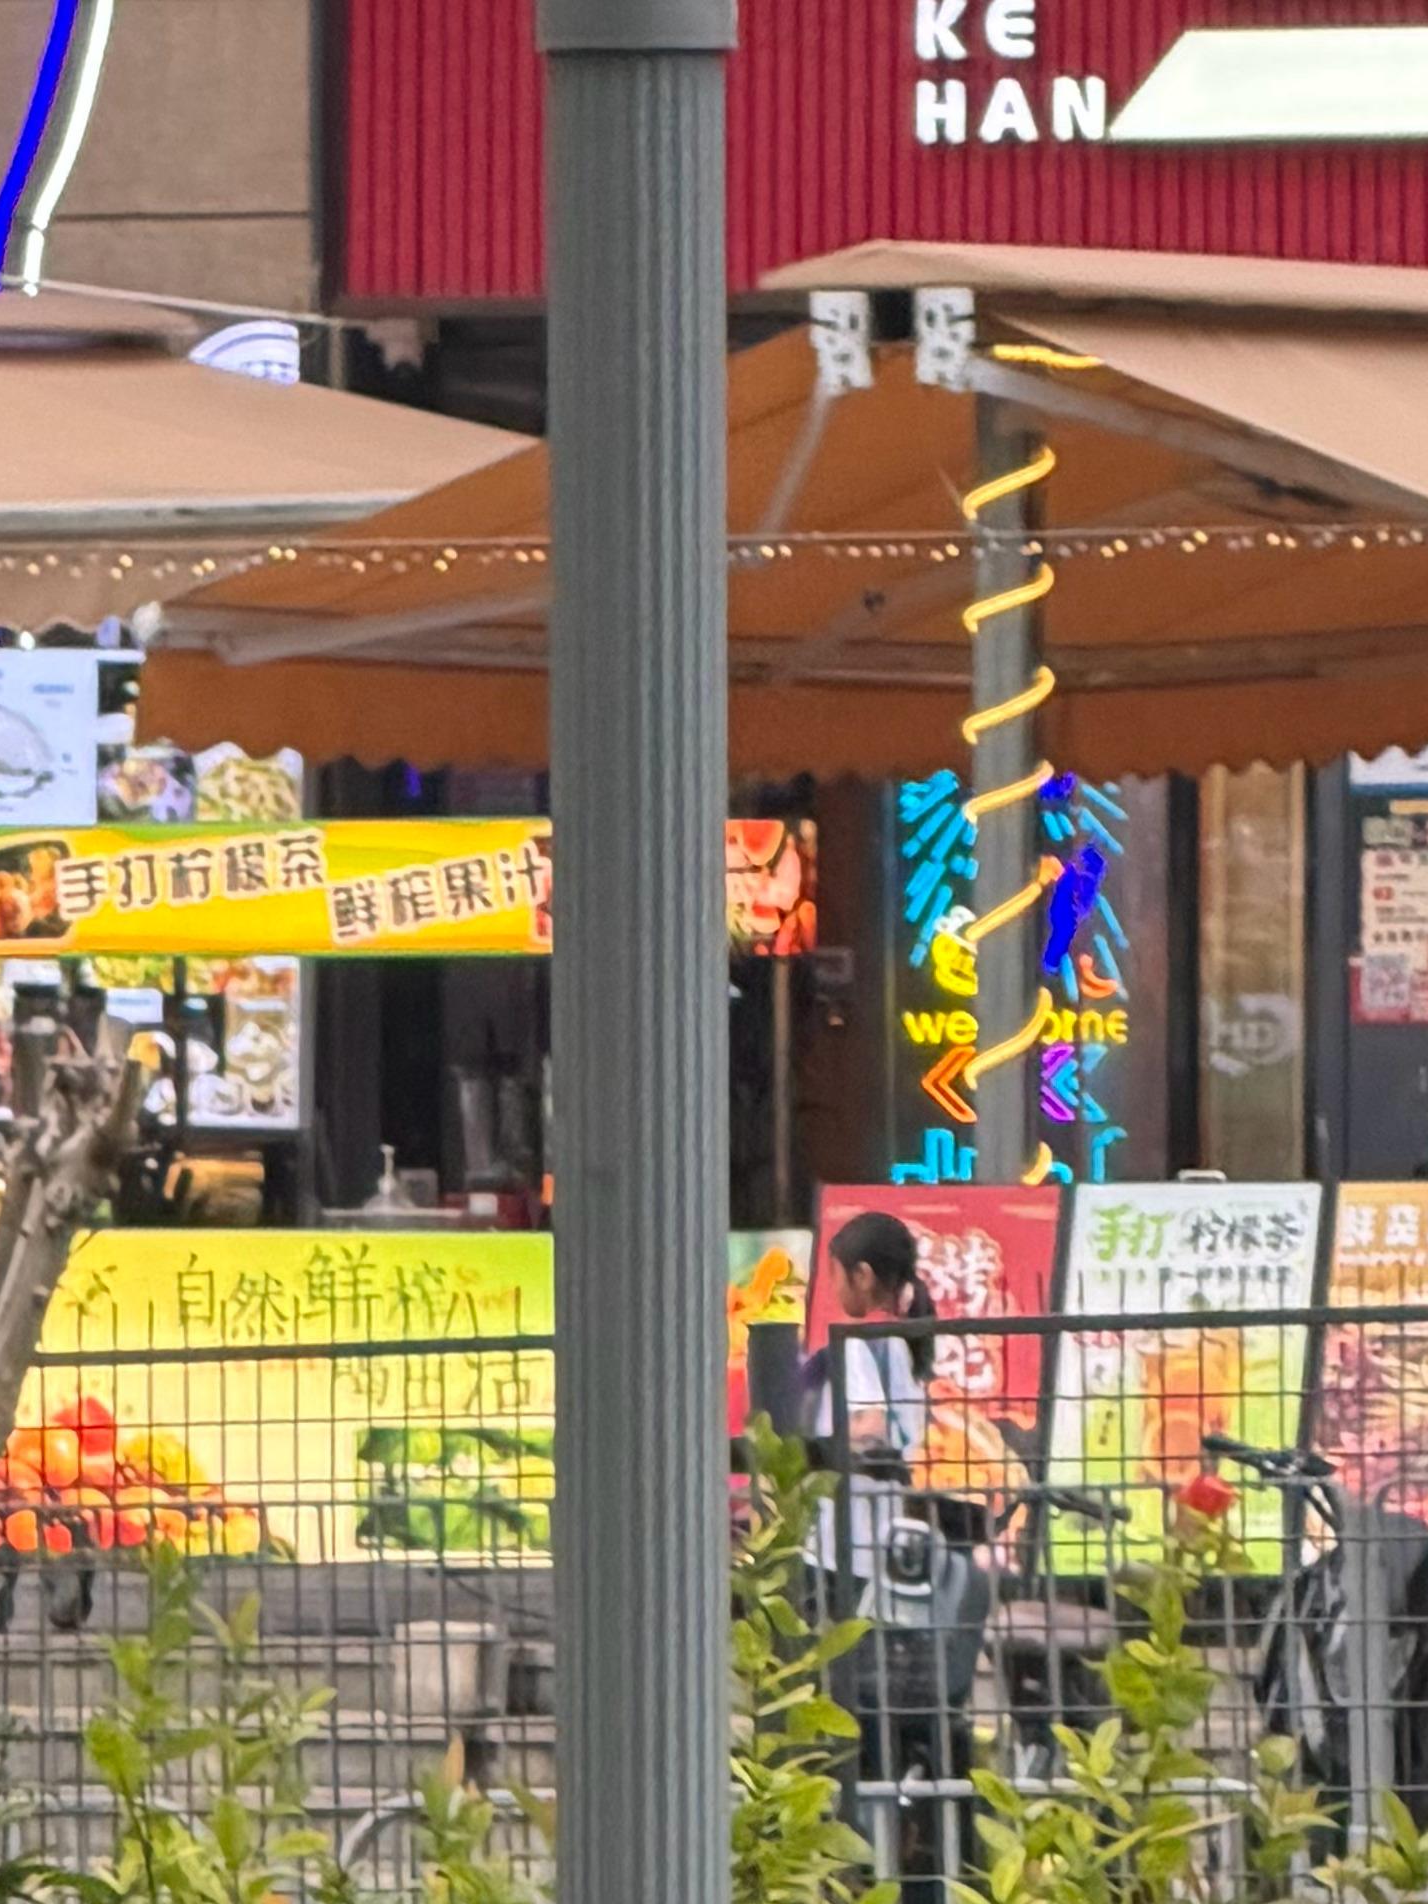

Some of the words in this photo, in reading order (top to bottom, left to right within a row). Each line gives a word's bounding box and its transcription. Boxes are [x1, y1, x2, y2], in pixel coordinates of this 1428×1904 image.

[915, 0, 1037, 60] KE
[915, 74, 1107, 145] HAN
[60, 833, 324, 914] 手打柠檬茶
[332, 848, 546, 940] 鲜榨果汁
